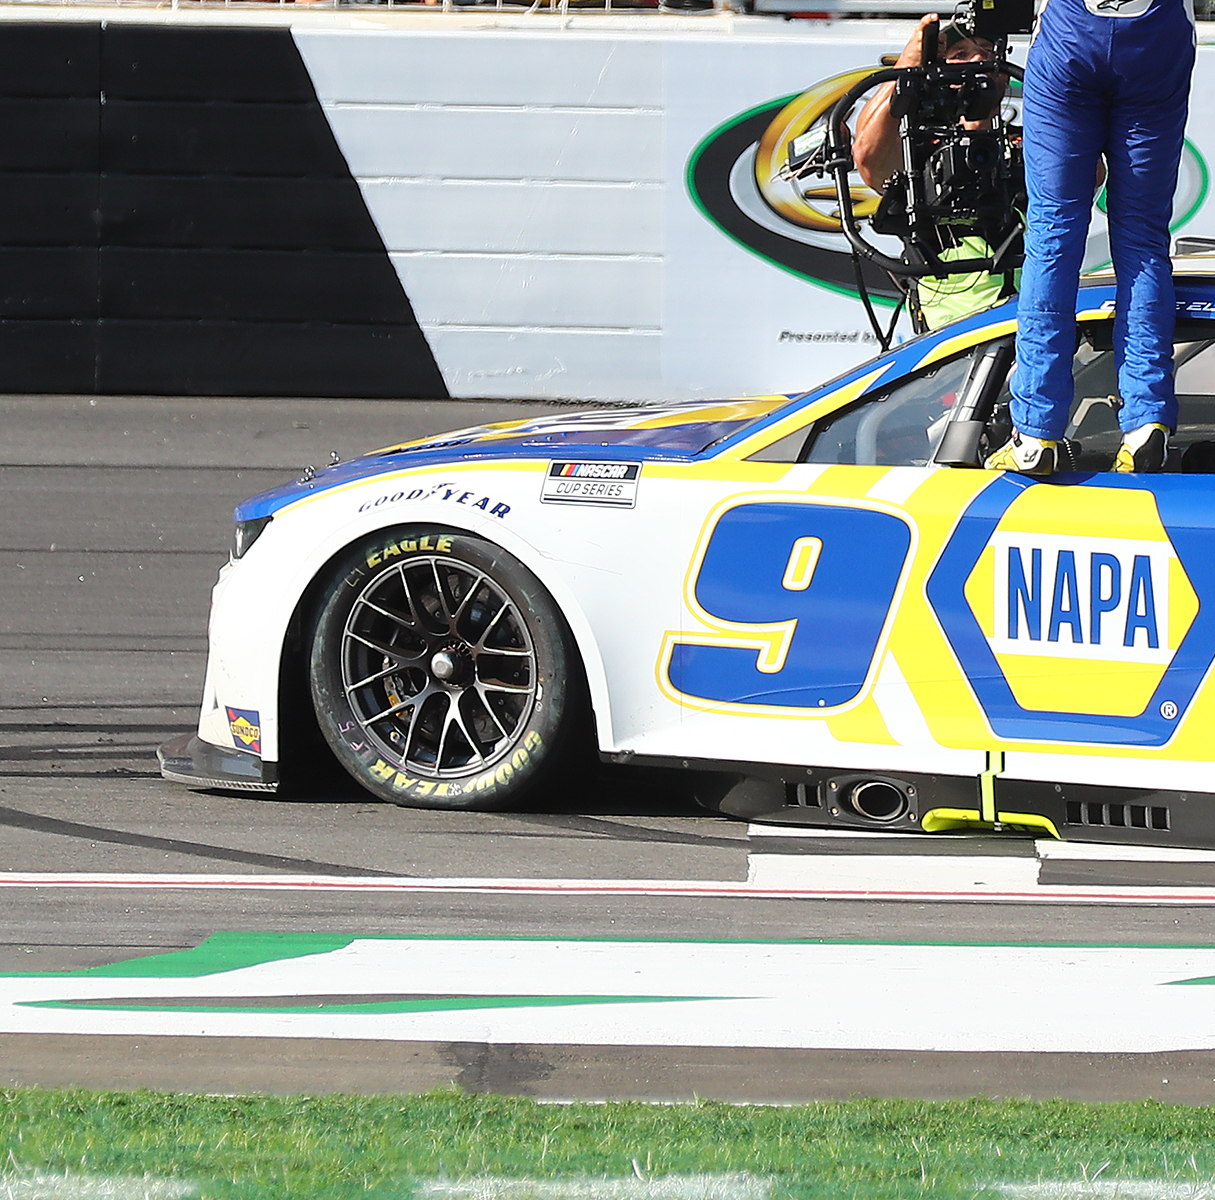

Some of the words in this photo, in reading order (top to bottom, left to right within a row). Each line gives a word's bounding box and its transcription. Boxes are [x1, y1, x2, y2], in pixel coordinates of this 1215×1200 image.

[779, 329, 859, 343] Presented
[576, 463, 629, 479] NASCAR
[555, 482, 581, 495] CUP
[583, 483, 624, 497] SERIES
[365, 533, 456, 569] EAGLE
[662, 497, 916, 712] 9
[1006, 546, 1160, 650] NAPA
[231, 723, 260, 739] SUNOCO
